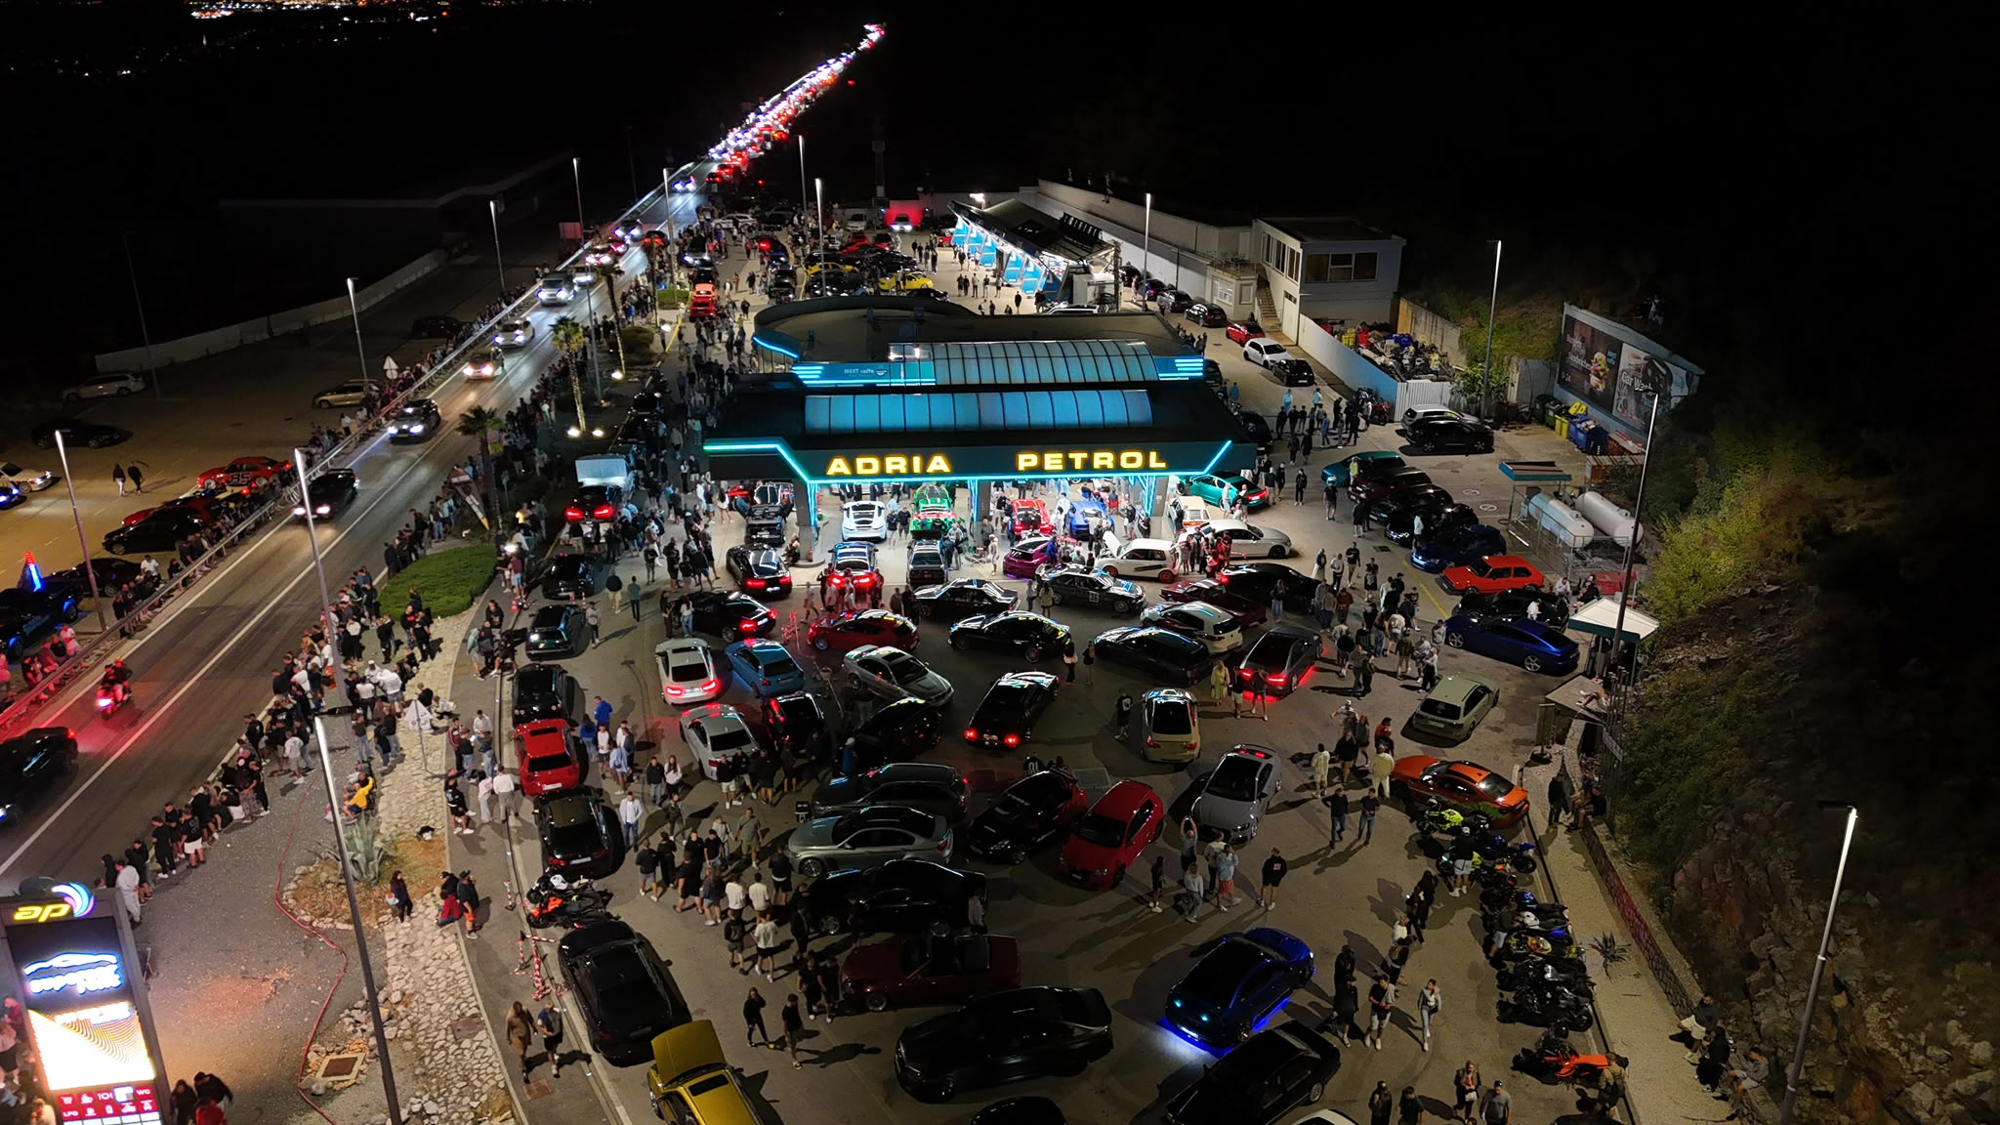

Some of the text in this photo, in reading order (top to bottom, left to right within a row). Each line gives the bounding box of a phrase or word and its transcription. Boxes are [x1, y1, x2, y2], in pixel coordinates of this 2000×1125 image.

[1621, 371, 1633, 386] Car
[826, 451, 1167, 475] ADRIA PETROL
[13, 904, 71, 922] ap
[136, 1088, 151, 1096] WC
[62, 1110, 79, 1118] LPG
